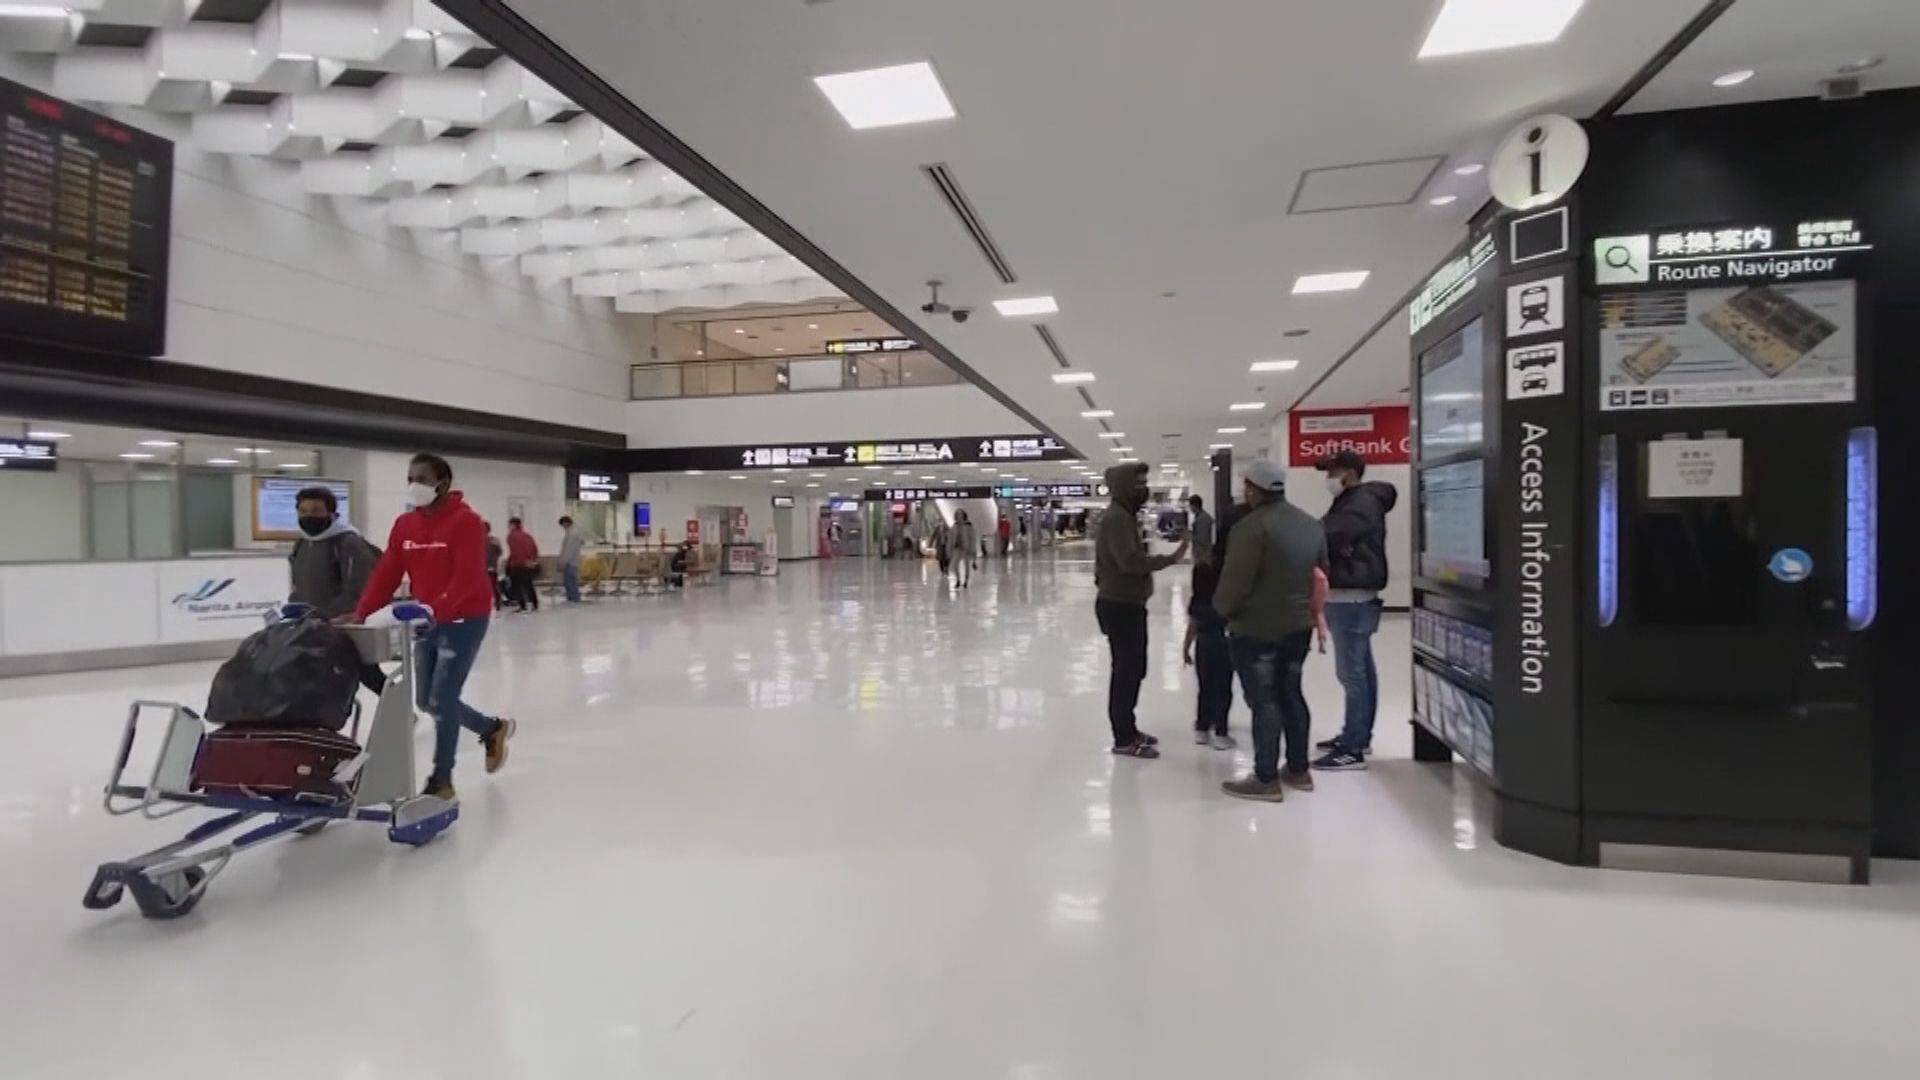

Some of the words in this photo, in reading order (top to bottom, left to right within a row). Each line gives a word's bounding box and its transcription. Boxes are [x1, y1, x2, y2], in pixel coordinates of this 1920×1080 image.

[1656, 227, 1772, 255] 乗換案内
[1658, 264, 1721, 281] Route
[1727, 257, 1836, 279] Navigator
[938, 443, 953, 459] A
[1299, 438, 1393, 457] SoftBank
[1520, 422, 1548, 512] Access
[1521, 523, 1550, 694] Information
